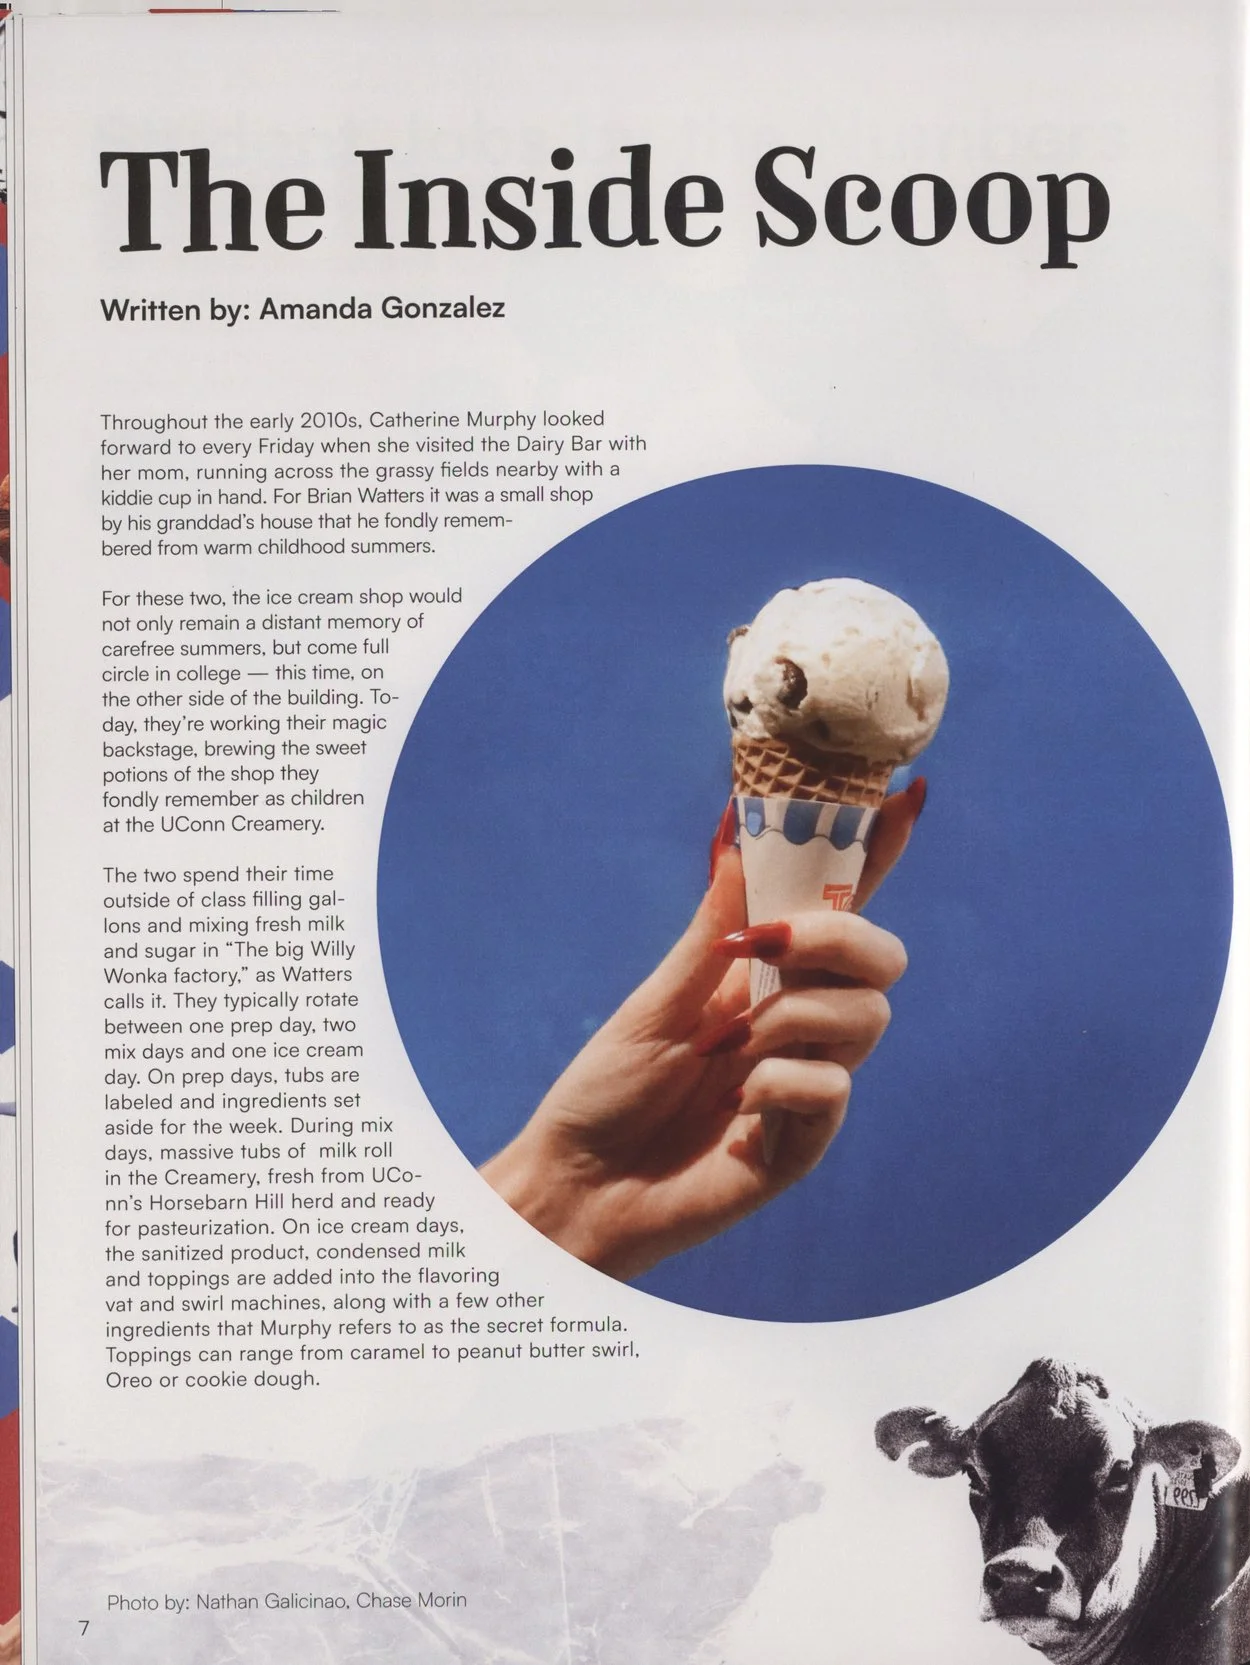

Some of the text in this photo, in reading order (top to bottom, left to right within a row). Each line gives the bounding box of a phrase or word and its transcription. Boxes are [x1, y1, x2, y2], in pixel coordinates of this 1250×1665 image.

[100, 144, 1109, 269] The Inside Scoop
[100, 295, 505, 327] Written by: Amanda Gonzalez
[100, 410, 604, 434] Throughout the early 2010s, Catherine Murphy looked
[103, 587, 462, 608] For these two, the ice cream shop would
[103, 865, 334, 886] The two spend their time
[104, 940, 355, 962] and sugar in “The big Willy
[104, 966, 352, 987] Wonka factory,” as Watters
[105, 1167, 422, 1188] in the Creamery, fresh from UCo-
[106, 1192, 435, 1212] nn’s Horsebarn Hill herd and ready
[106, 1341, 639, 1367] Toppings can range from caramel to peanut butter swirl,
[106, 1370, 319, 1390] Oreo or cookie dough.
[108, 1592, 466, 1614] Photo by: Nathan Galicinao, Chase Morin
[78, 1620, 89, 1636] 7
